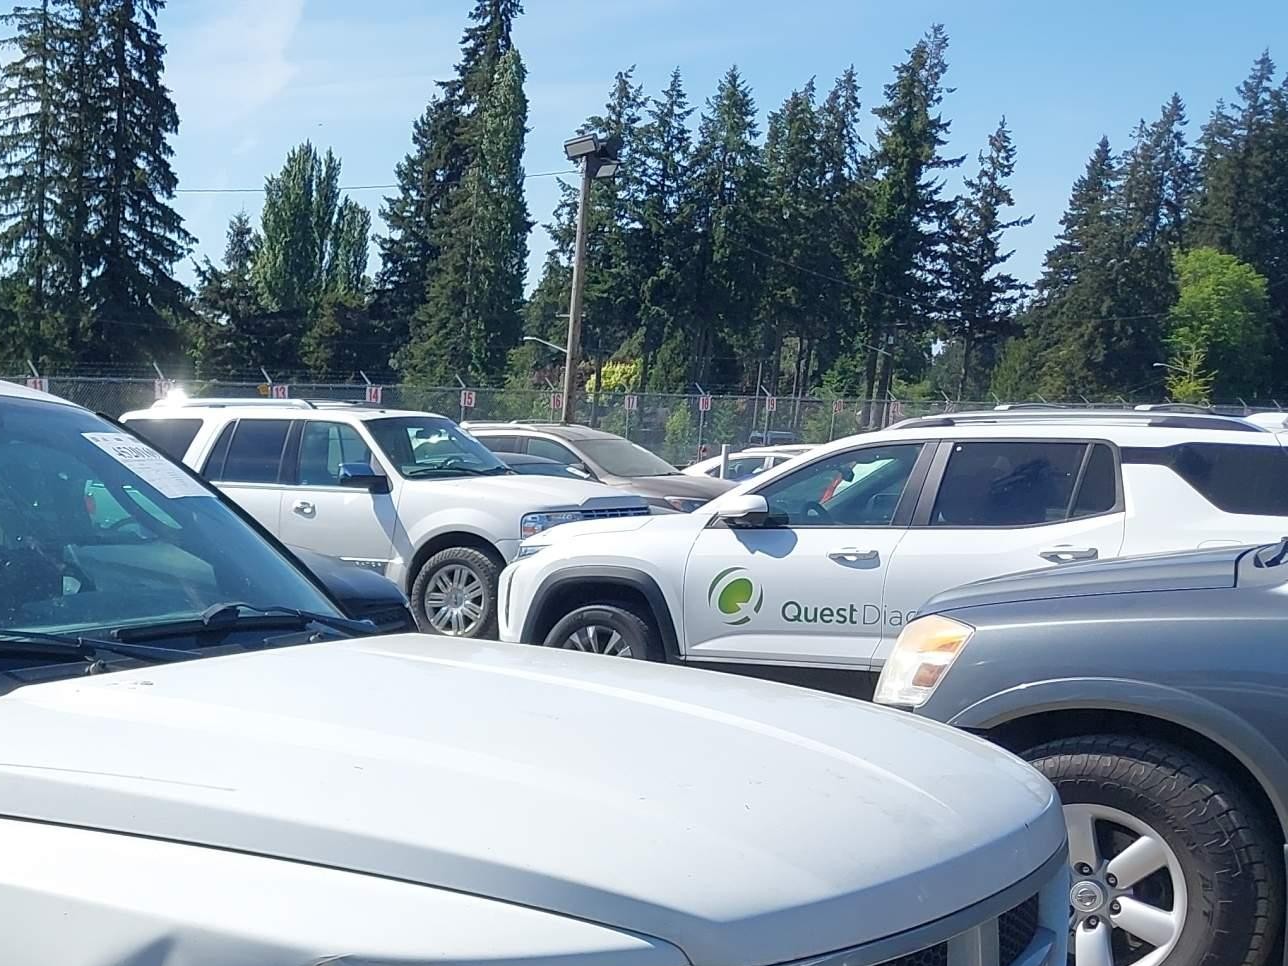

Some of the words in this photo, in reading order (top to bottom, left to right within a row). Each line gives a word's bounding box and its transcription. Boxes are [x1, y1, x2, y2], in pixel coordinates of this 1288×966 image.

[274, 386, 286, 398] 13
[368, 387, 377, 402] 14
[462, 391, 473, 405] 15
[552, 395, 561, 409] 16
[626, 396, 635, 409] 17
[701, 398, 709, 410] 18
[767, 398, 776, 409] 19
[781, 600, 858, 625] Quest
